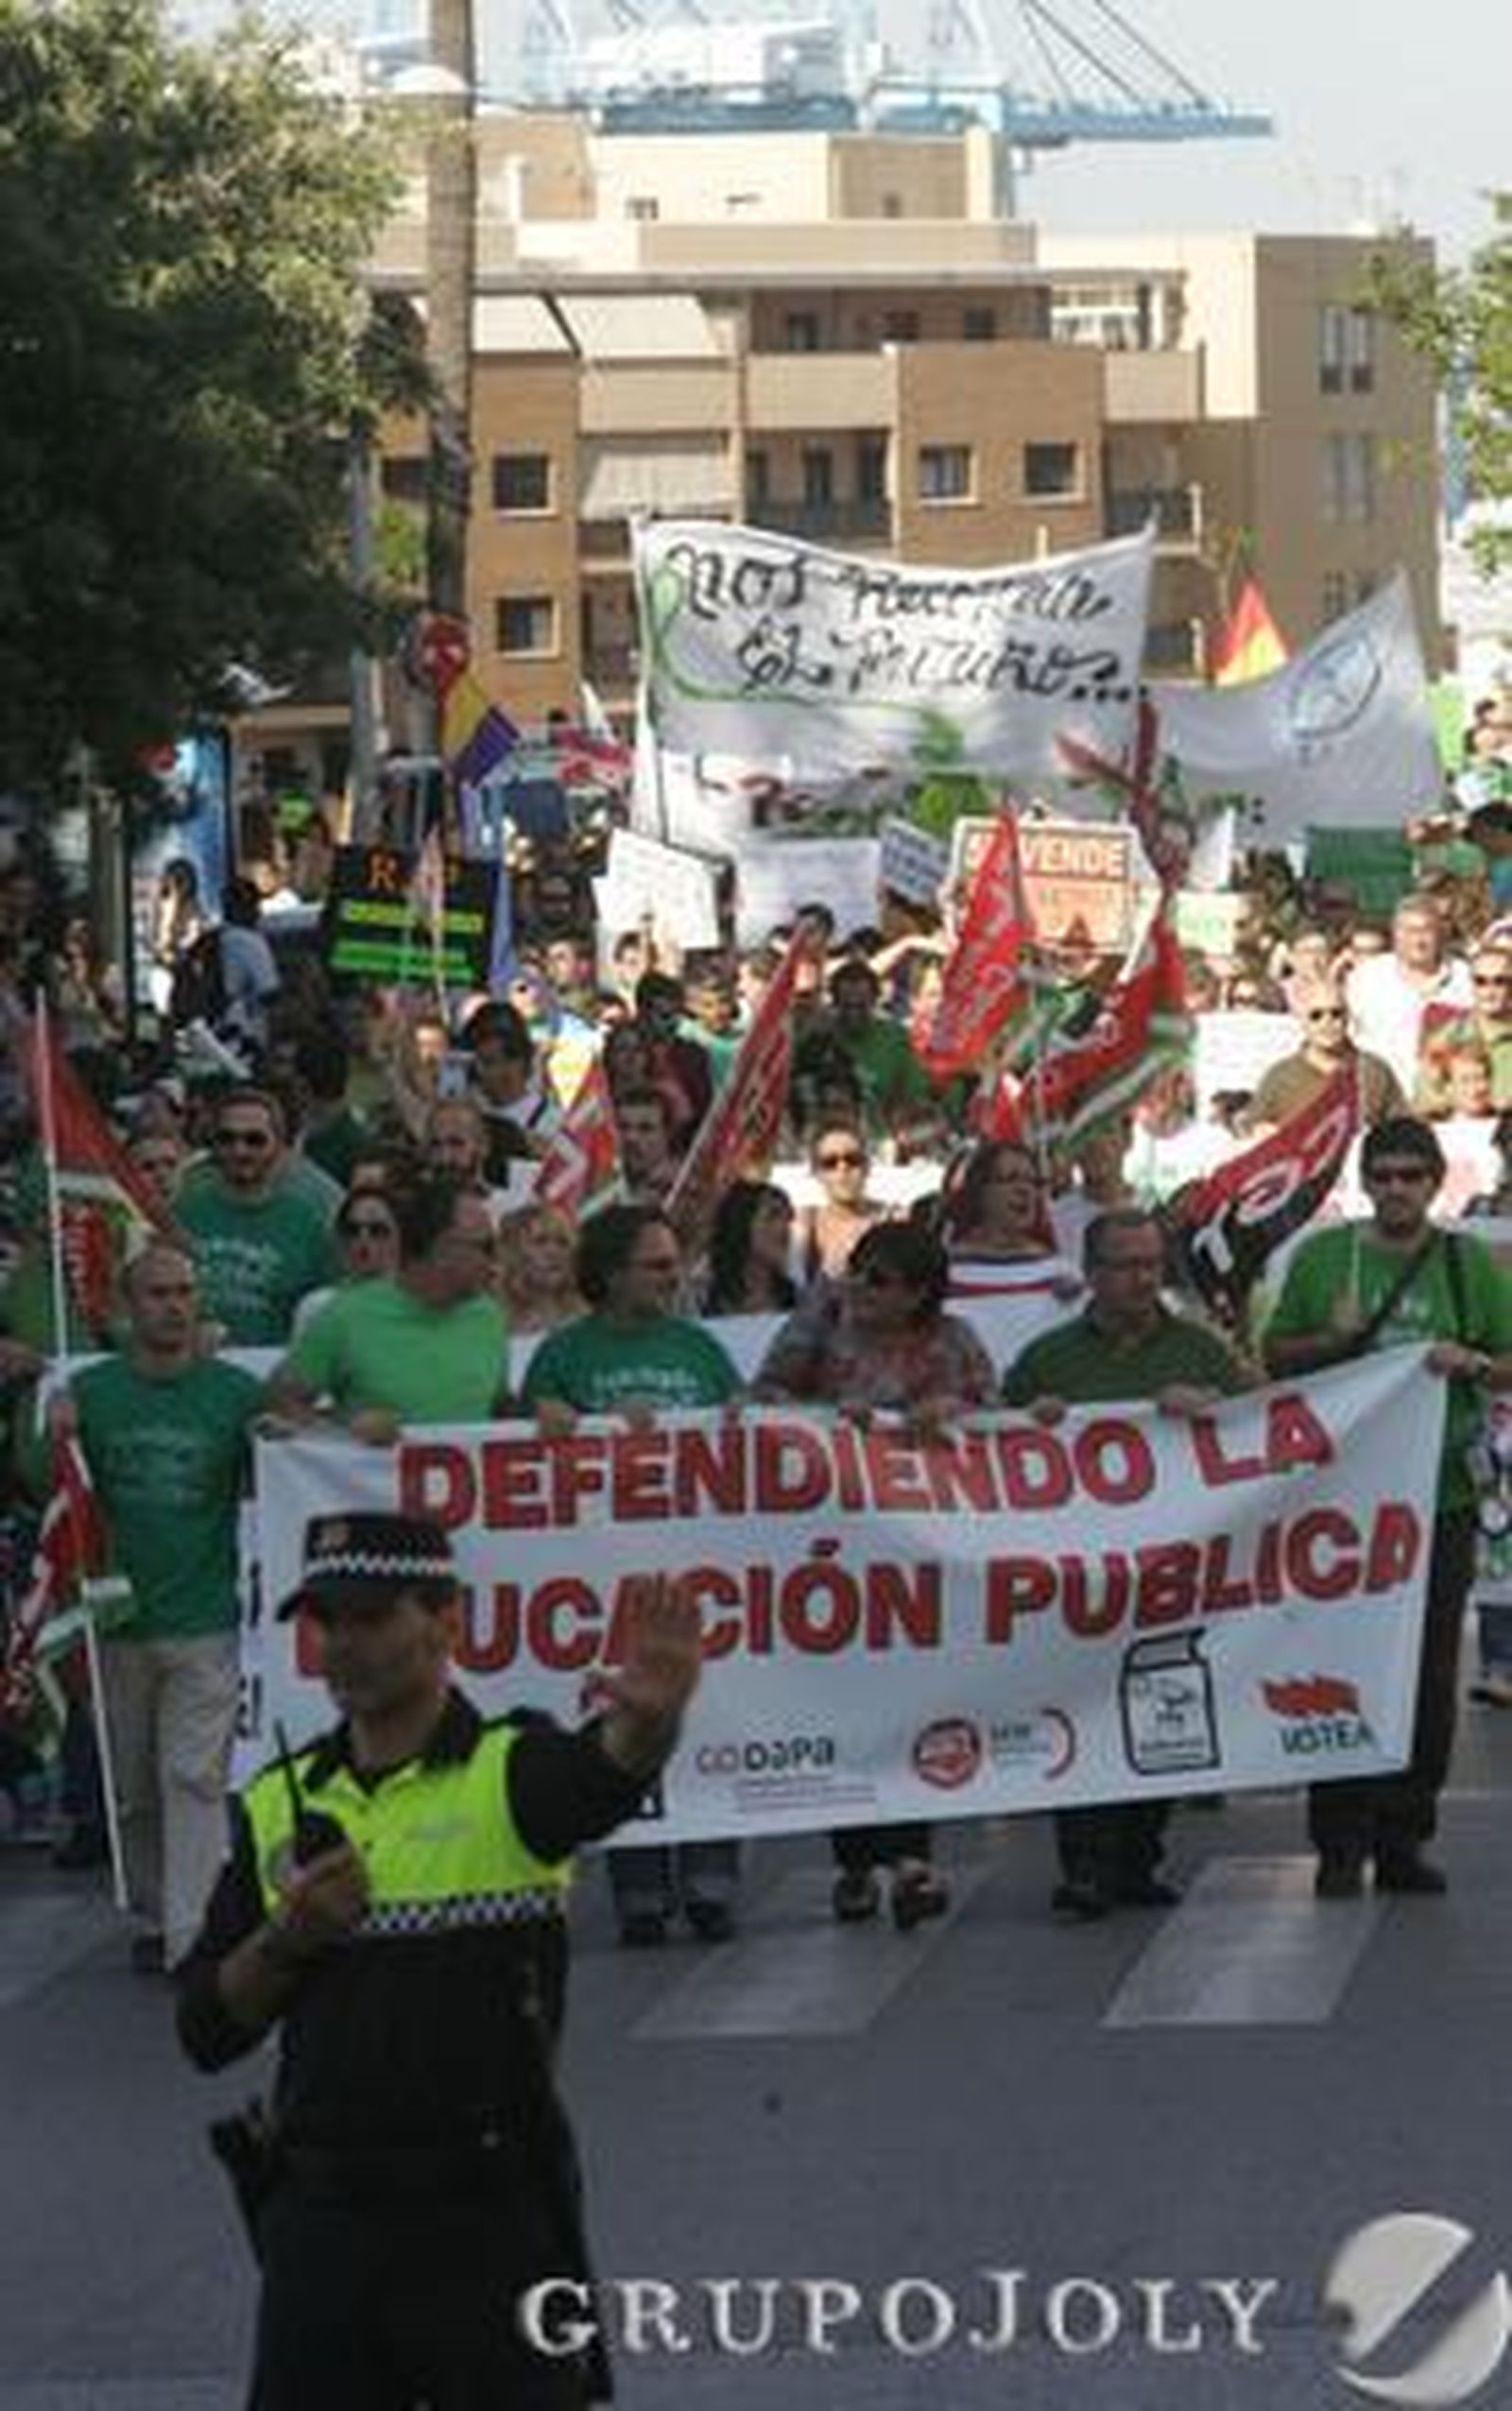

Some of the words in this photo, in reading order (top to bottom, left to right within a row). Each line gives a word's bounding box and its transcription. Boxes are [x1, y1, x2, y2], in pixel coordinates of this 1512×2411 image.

[397, 1419, 1156, 1532] DEFENDIENDO
[1193, 1392, 1334, 1490] LA
[295, 1537, 941, 1680] UCCIÓN
[985, 1499, 1421, 1645] PUBLICA
